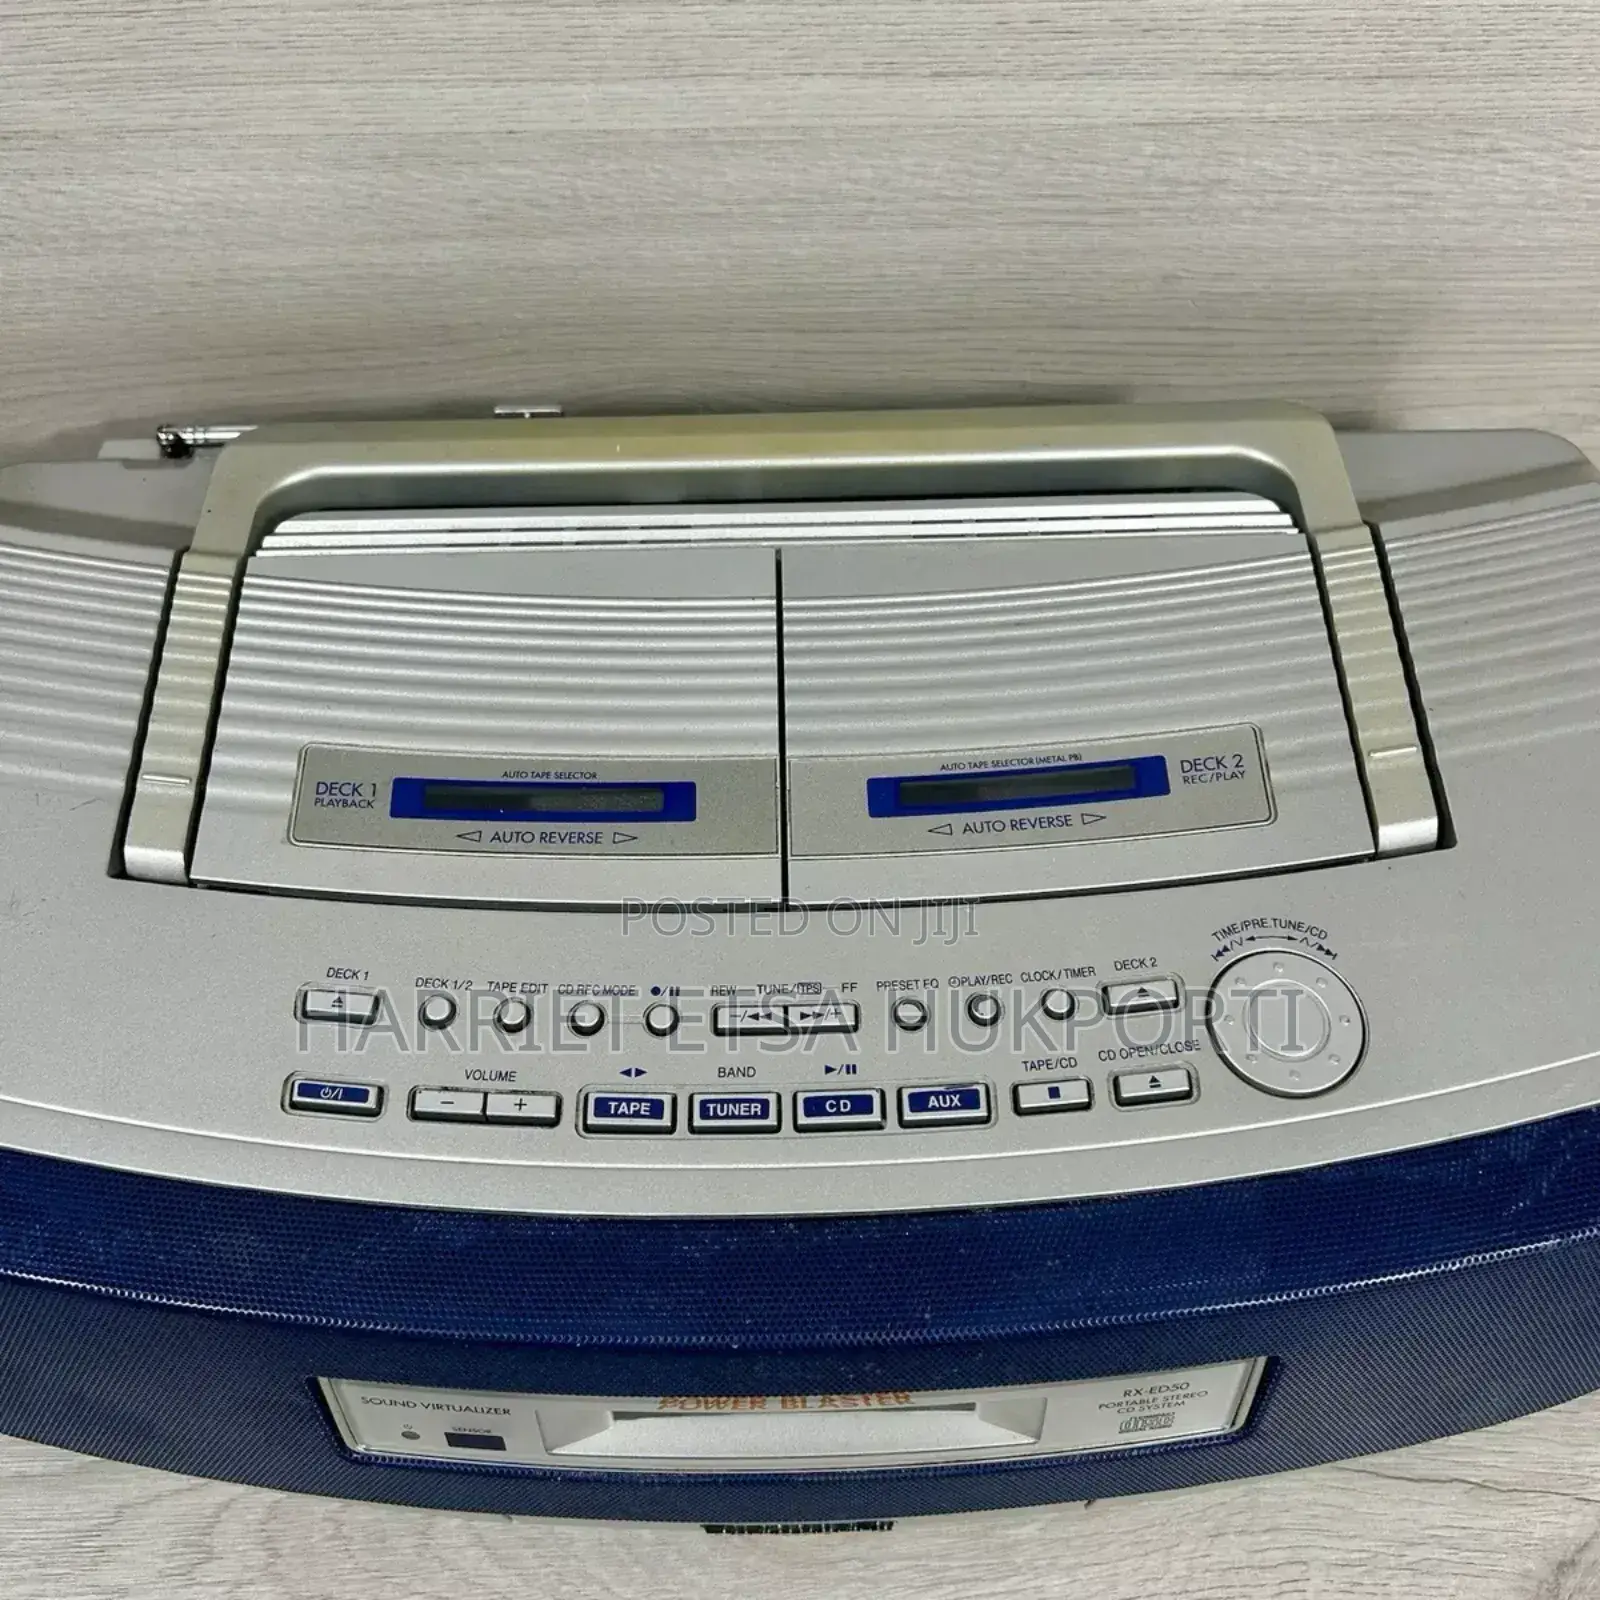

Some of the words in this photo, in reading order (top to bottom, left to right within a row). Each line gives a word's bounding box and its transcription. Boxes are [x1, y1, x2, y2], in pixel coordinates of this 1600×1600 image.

[940, 762, 964, 772] AUTO
[967, 760, 989, 770] TAPE
[991, 757, 1033, 768] SELECTOR
[1180, 757, 1228, 774] DECK
[1231, 754, 1245, 769] 2
[502, 770, 527, 779] AUTO
[530, 770, 553, 780] TAPE
[555, 771, 598, 780] SELECTOR
[1182, 770, 1246, 785] REC/PLAY
[315, 781, 366, 797] DECK
[369, 782, 377, 797] 1
[313, 797, 375, 809] PLAYBACK
[962, 819, 1006, 835] AUTO
[1010, 814, 1074, 831] REVERSE
[489, 830, 535, 844] AUTO
[538, 830, 603, 845] REVERSE
[1114, 959, 1146, 972] DECK
[1149, 957, 1158, 969] 2
[326, 967, 360, 979] DECK
[363, 970, 370, 981] 1
[415, 977, 449, 989] DECK
[452, 980, 473, 990] 1/2
[487, 981, 517, 993] TAPE
[520, 983, 549, 994] EDIT
[557, 984, 574, 995] CD
[602, 984, 636, 997] MODE
[841, 982, 858, 993] FF
[876, 980, 920, 992] PRESET
[923, 979, 940, 990] EQ
[710, 985, 737, 997] REW
[1098, 1049, 1117, 1062] CD
[1119, 1039, 1201, 1058] OPEN/CLOSE
[1022, 1057, 1078, 1072] TAPE/CD
[464, 1069, 517, 1082] VOLUME
[717, 1066, 756, 1078] BAND
[607, 1101, 651, 1115] TAPE
[825, 1099, 851, 1113] CD
[927, 1094, 962, 1109] AUX
[707, 1103, 762, 1117] TUNER
[361, 1396, 417, 1409] SOUND
[419, 1401, 512, 1416] VIRTUALIZER
[1098, 1396, 1157, 1409] PORTABLE
[1163, 1390, 1209, 1401] STEREO
[1116, 1406, 1135, 1414] CD
